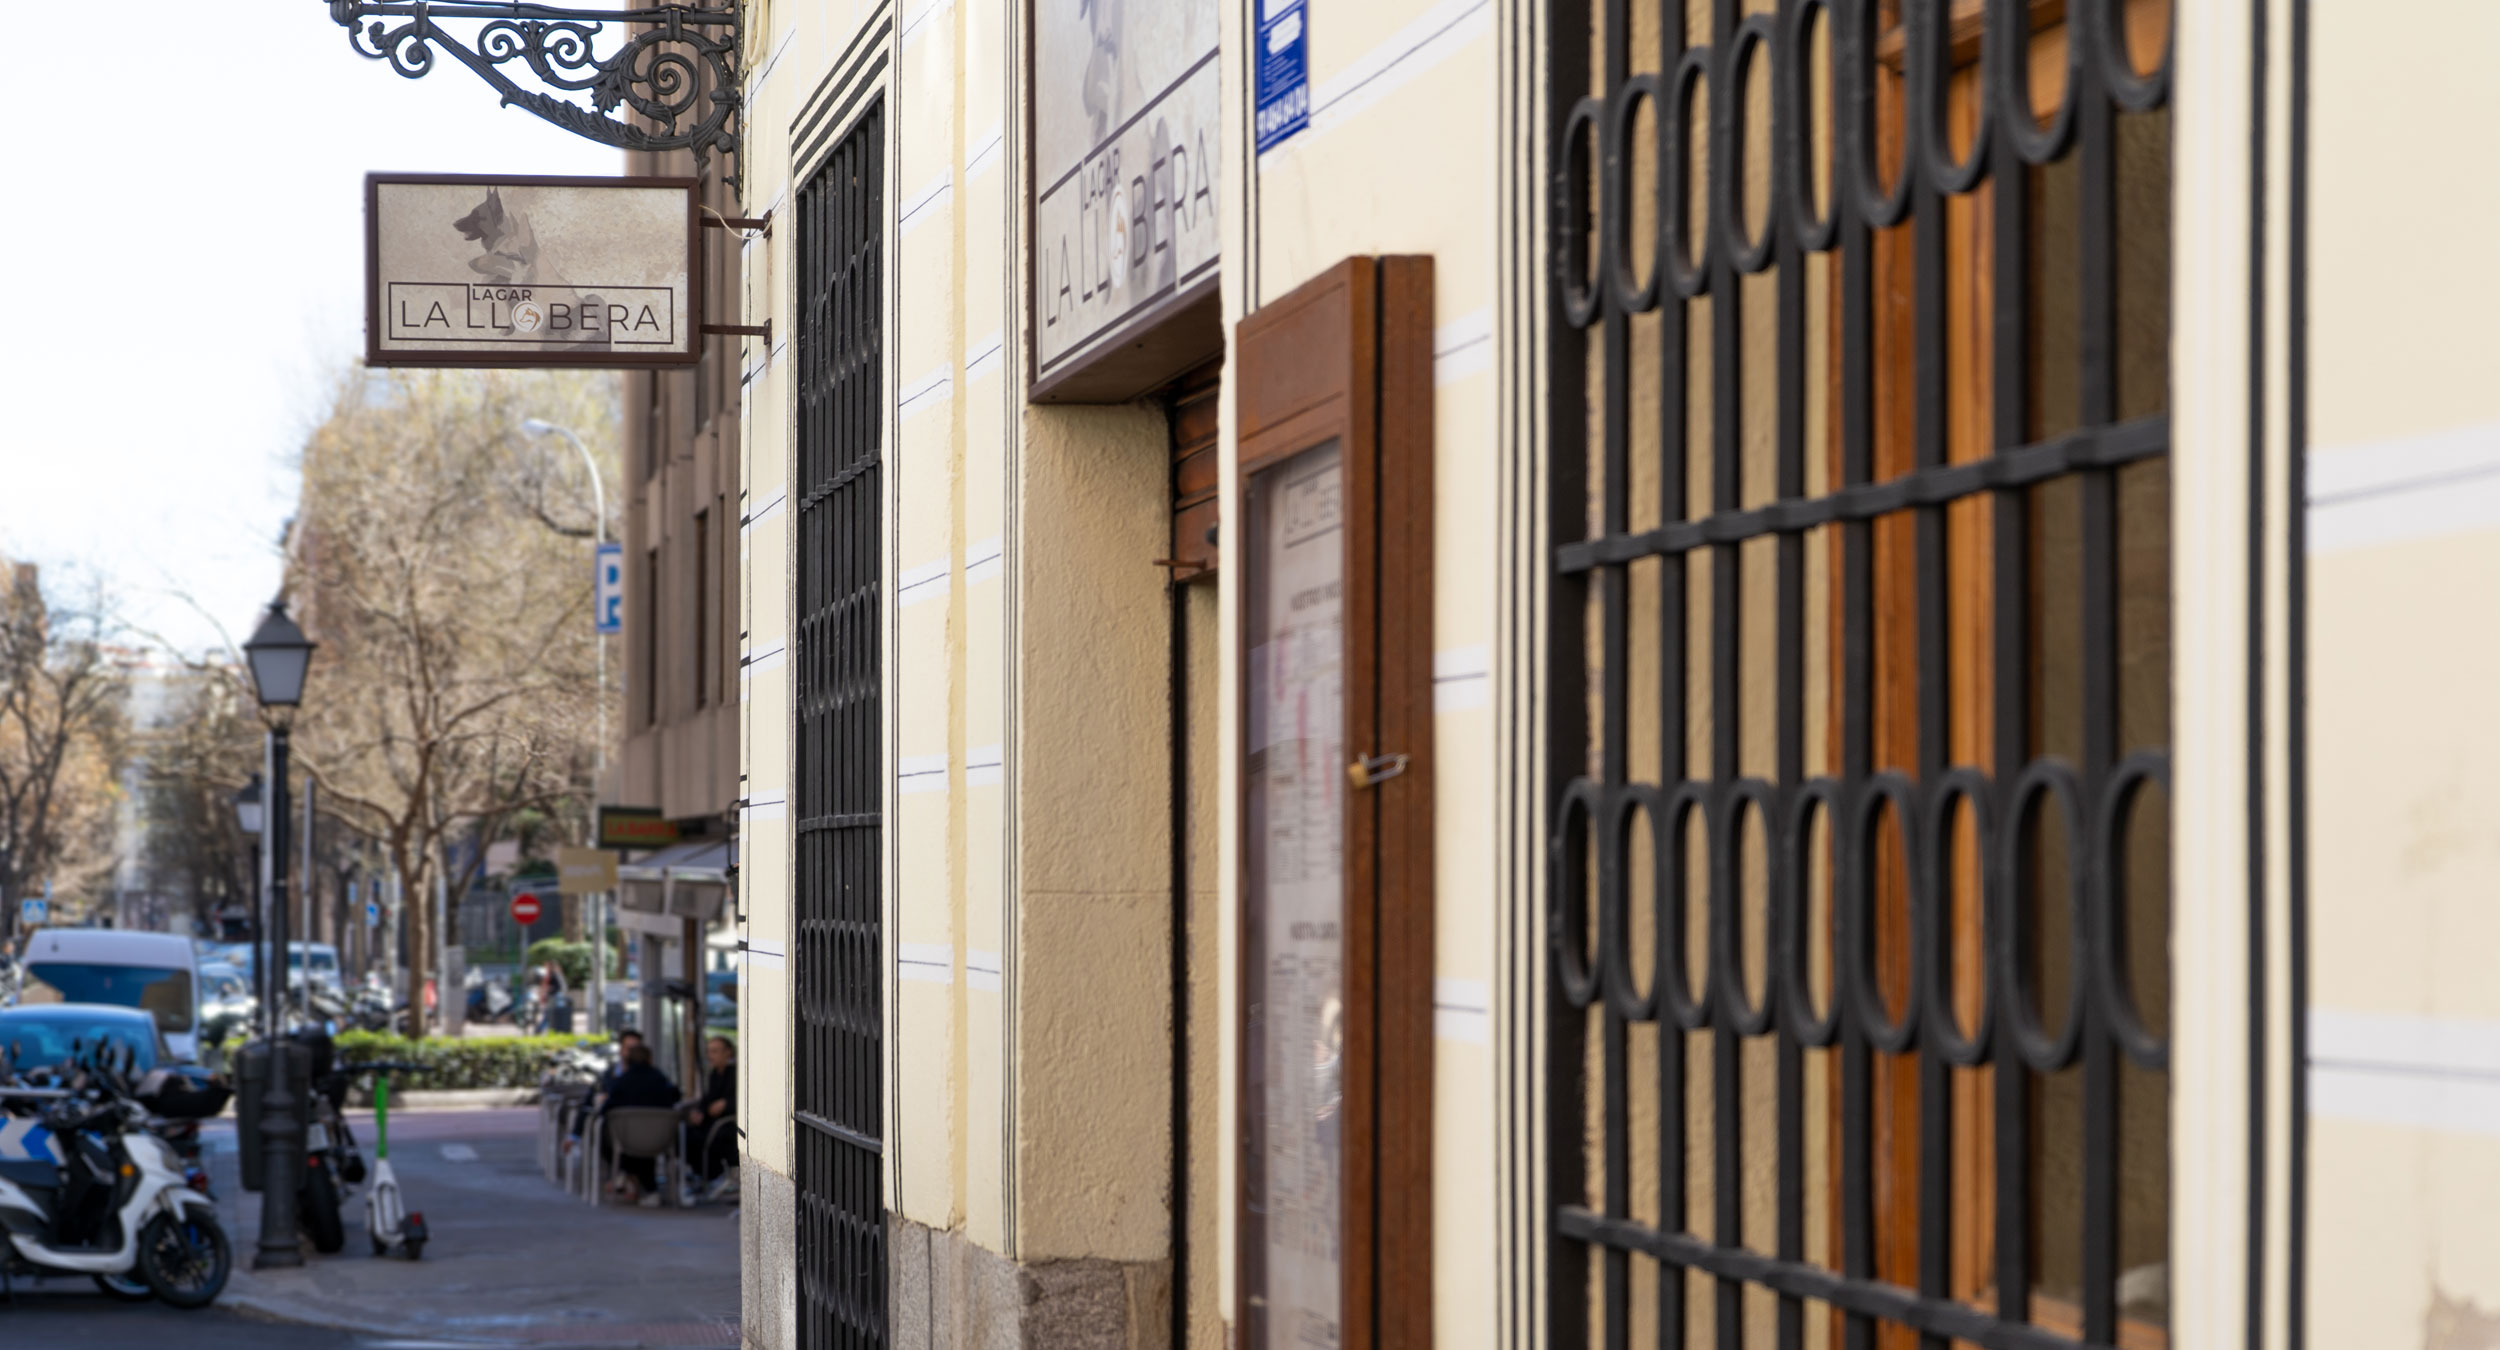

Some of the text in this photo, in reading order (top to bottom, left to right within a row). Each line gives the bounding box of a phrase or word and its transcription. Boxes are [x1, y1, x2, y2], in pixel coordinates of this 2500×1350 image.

[1083, 147, 1121, 211] LAGAR
[1045, 127, 1214, 328] LA LLOBERA
[402, 299, 661, 333] LA LLOBERA
[472, 288, 534, 302] LAGAR
[599, 553, 622, 624] P
